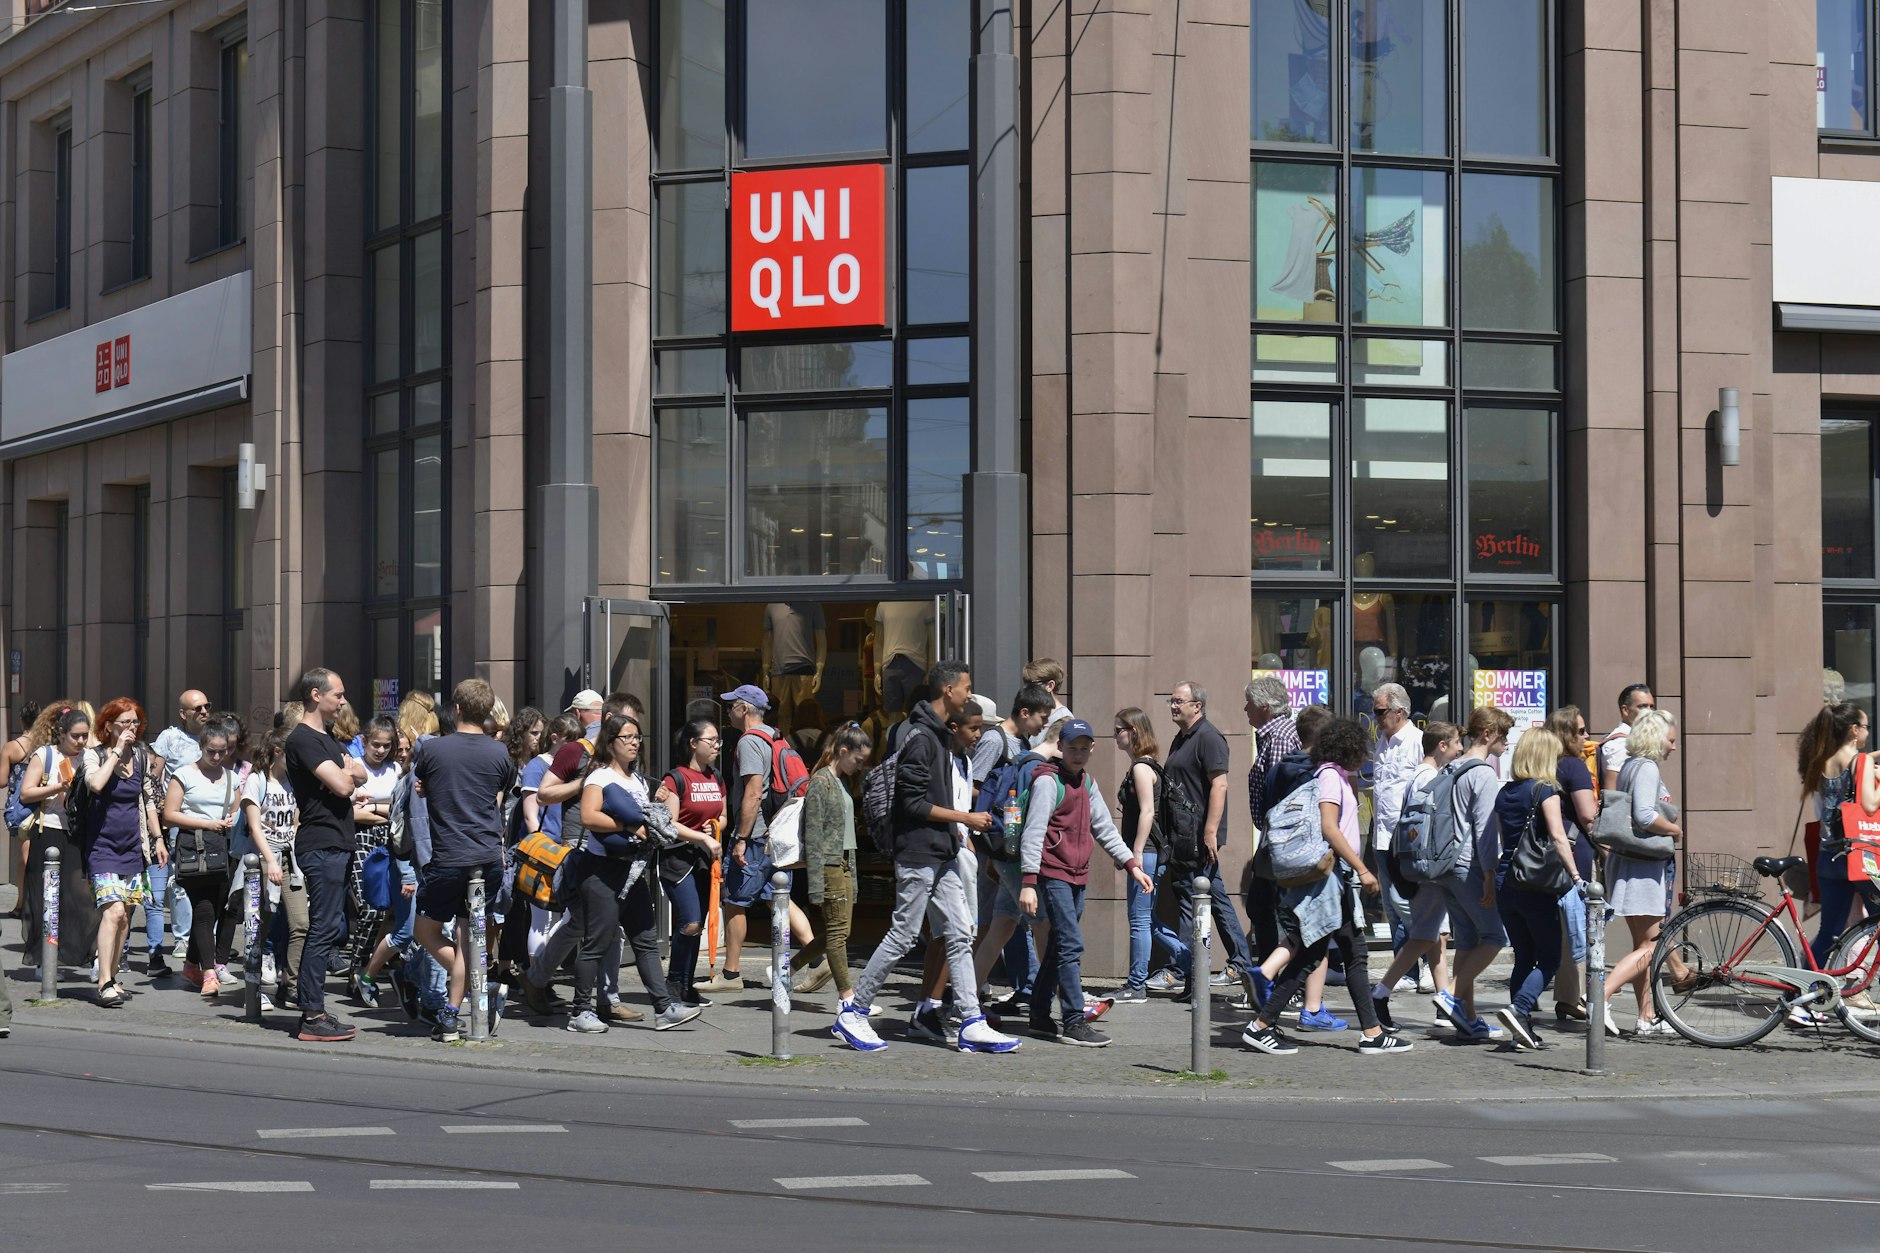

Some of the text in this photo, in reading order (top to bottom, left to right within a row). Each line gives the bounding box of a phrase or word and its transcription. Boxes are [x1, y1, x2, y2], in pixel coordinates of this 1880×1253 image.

[750, 187, 850, 244] UNI
[750, 253, 861, 318] QLO
[116, 342, 128, 361] UNI
[115, 362, 128, 383] QLO
[1253, 530, 1320, 554] Berlin
[1476, 534, 1540, 560] Berlin
[1475, 671, 1545, 689] SOMMER
[1475, 692, 1545, 707] SPECIALS
